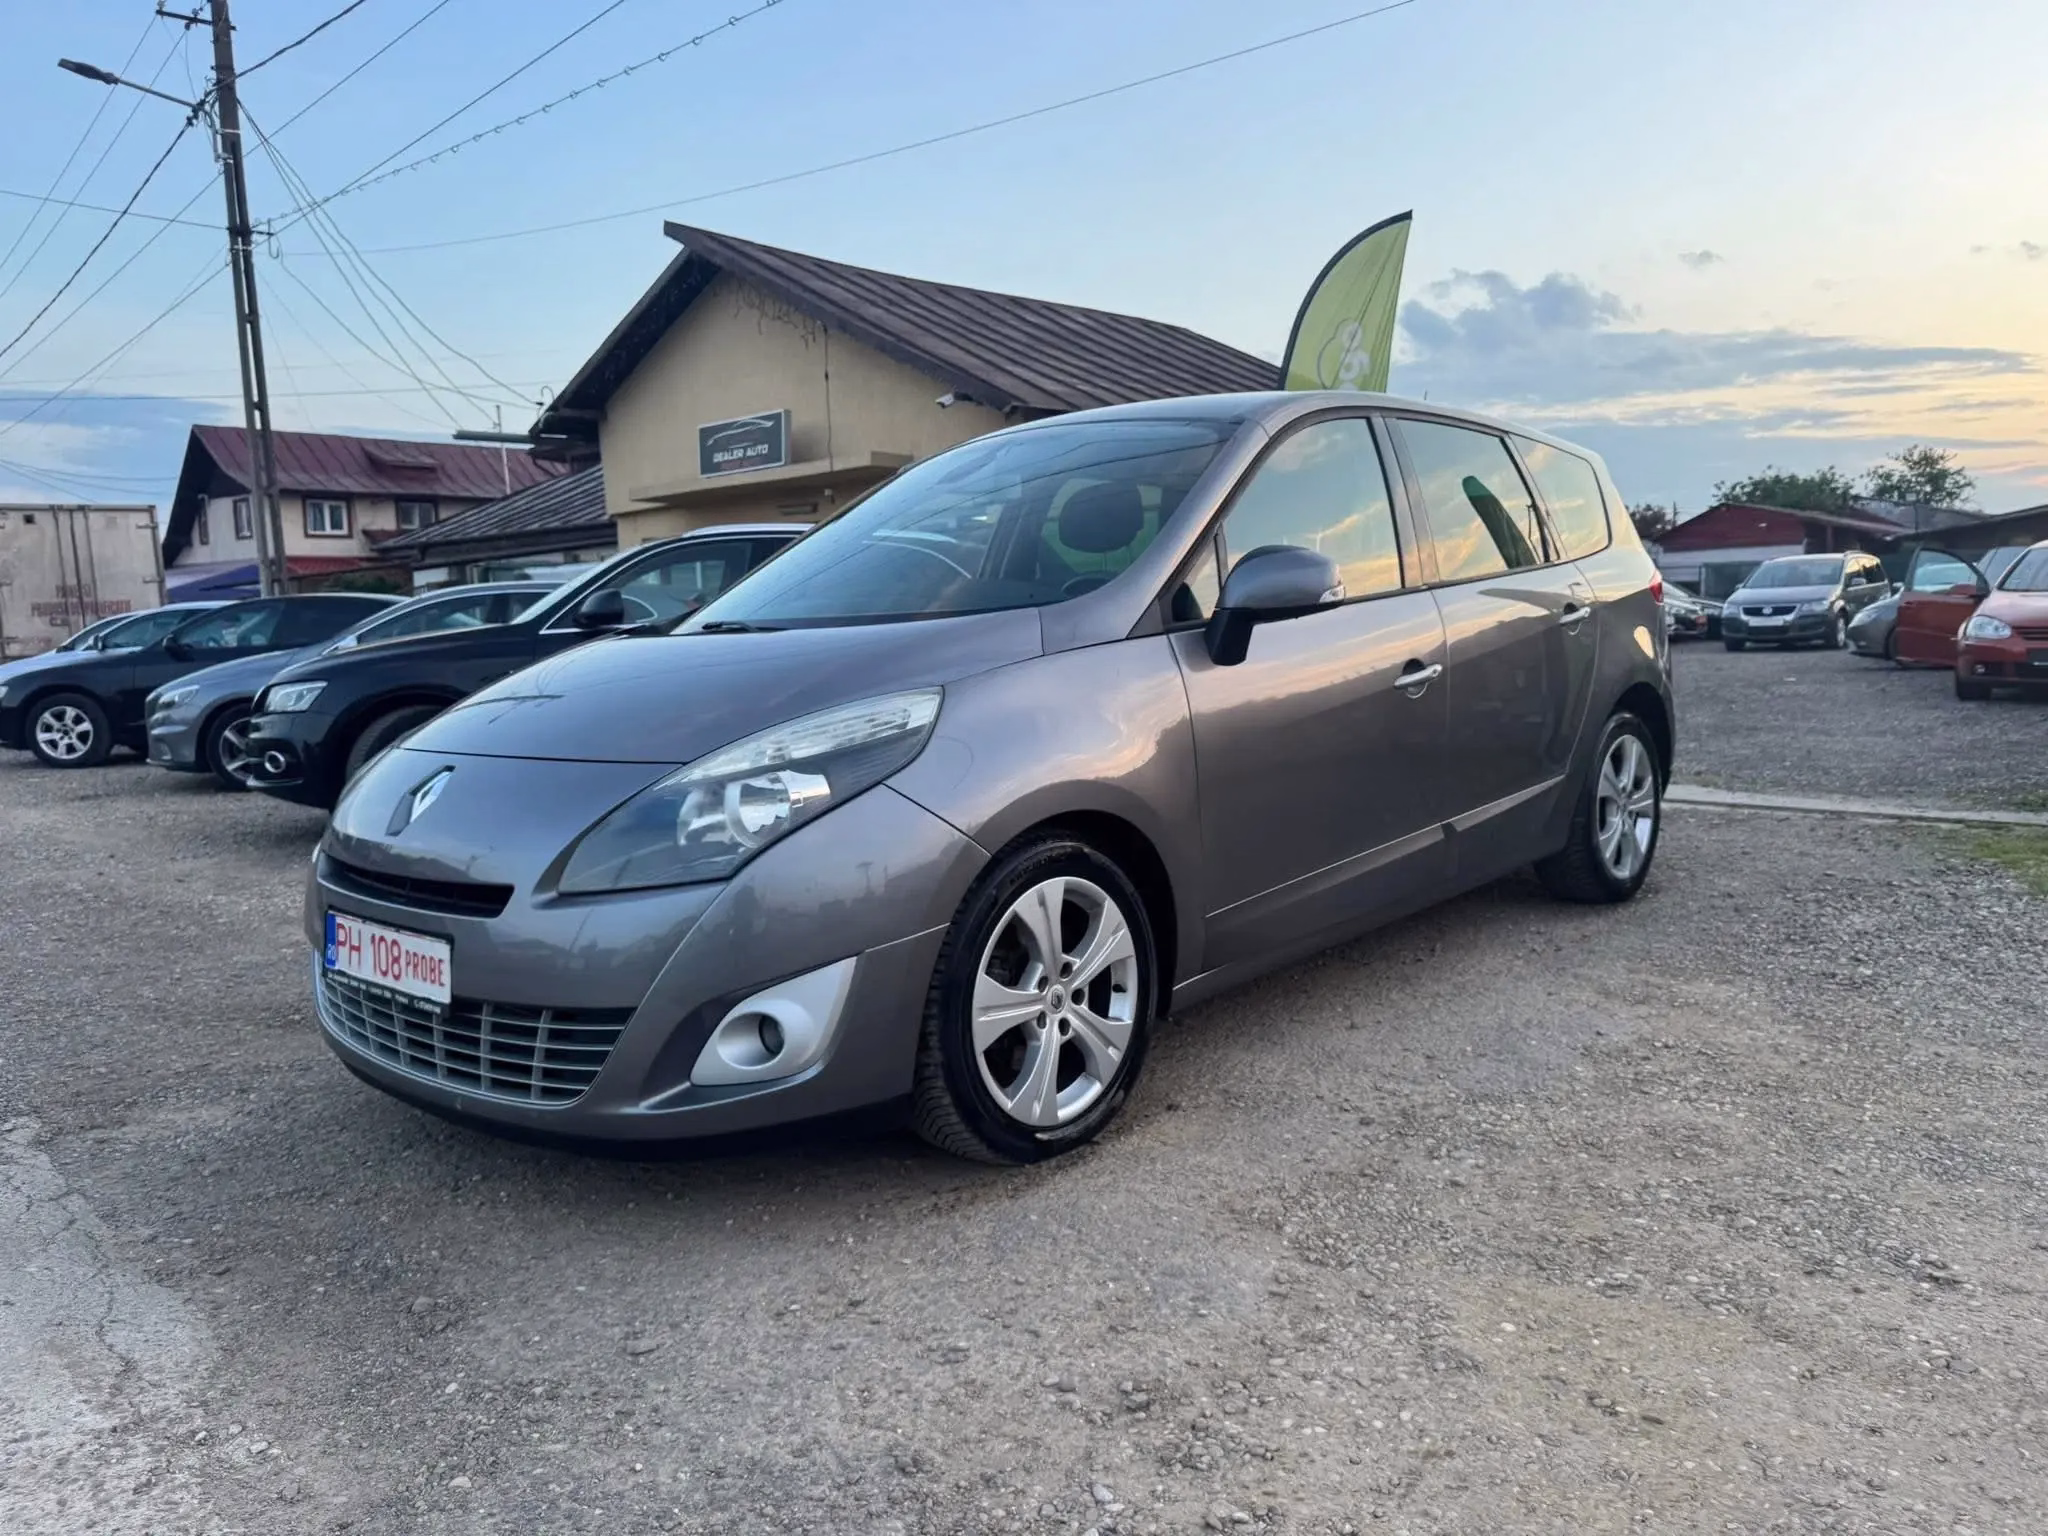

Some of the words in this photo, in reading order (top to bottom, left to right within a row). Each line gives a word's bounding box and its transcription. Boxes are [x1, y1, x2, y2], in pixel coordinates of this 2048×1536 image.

[712, 448, 744, 463] DEALER
[745, 444, 769, 457] AUTO
[336, 922, 361, 969] PH
[371, 933, 402, 981] 108
[405, 949, 446, 987] PROBE
